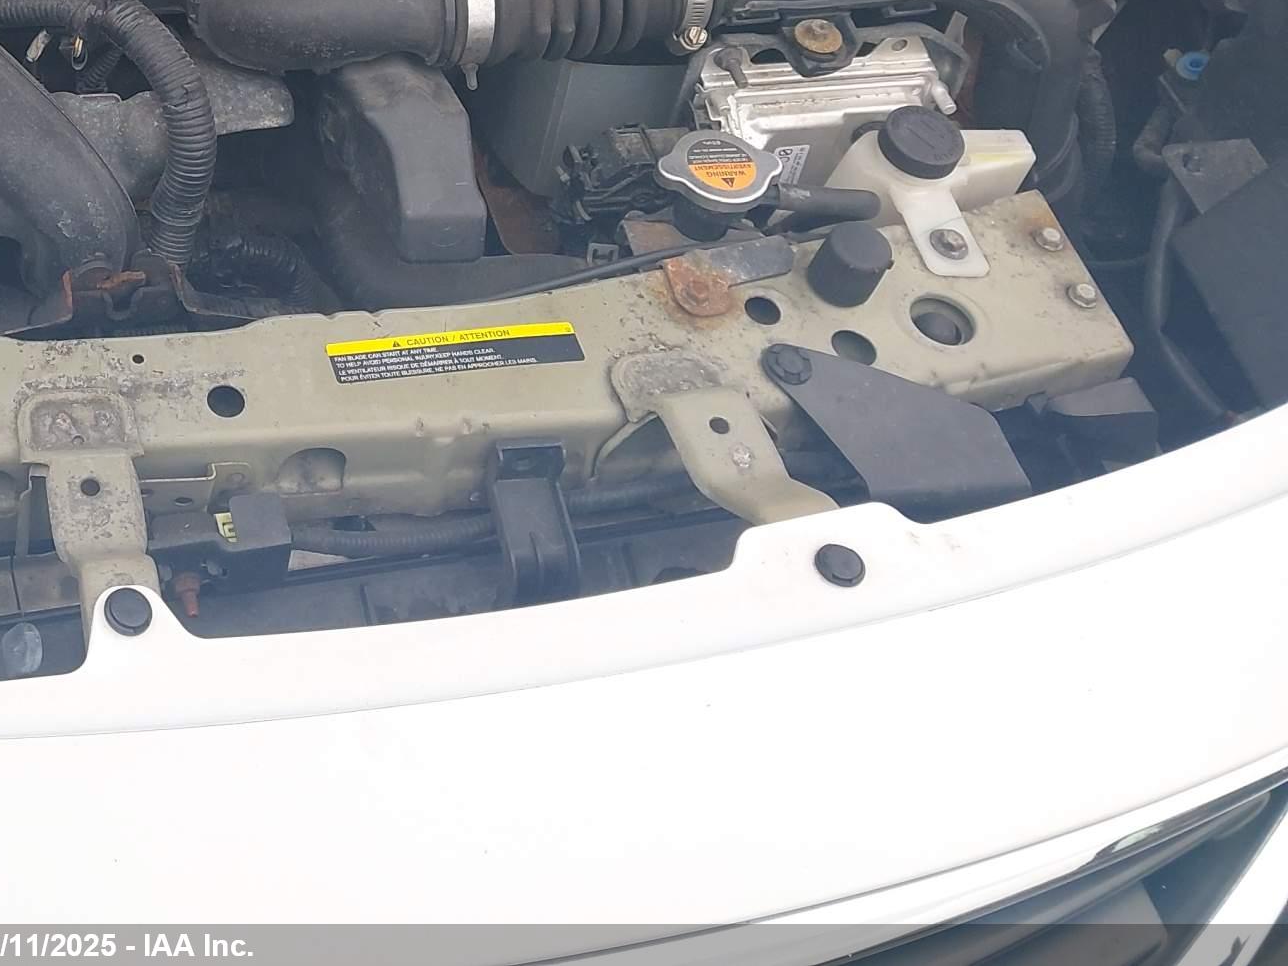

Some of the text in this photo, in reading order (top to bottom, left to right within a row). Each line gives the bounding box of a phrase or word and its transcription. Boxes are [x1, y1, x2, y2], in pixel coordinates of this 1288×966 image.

[406, 336, 449, 346] CAUTION
[459, 330, 510, 341] ATTENTION
[467, 360, 504, 369] APPROCHER
[347, 366, 386, 375] VENTILATEUR
